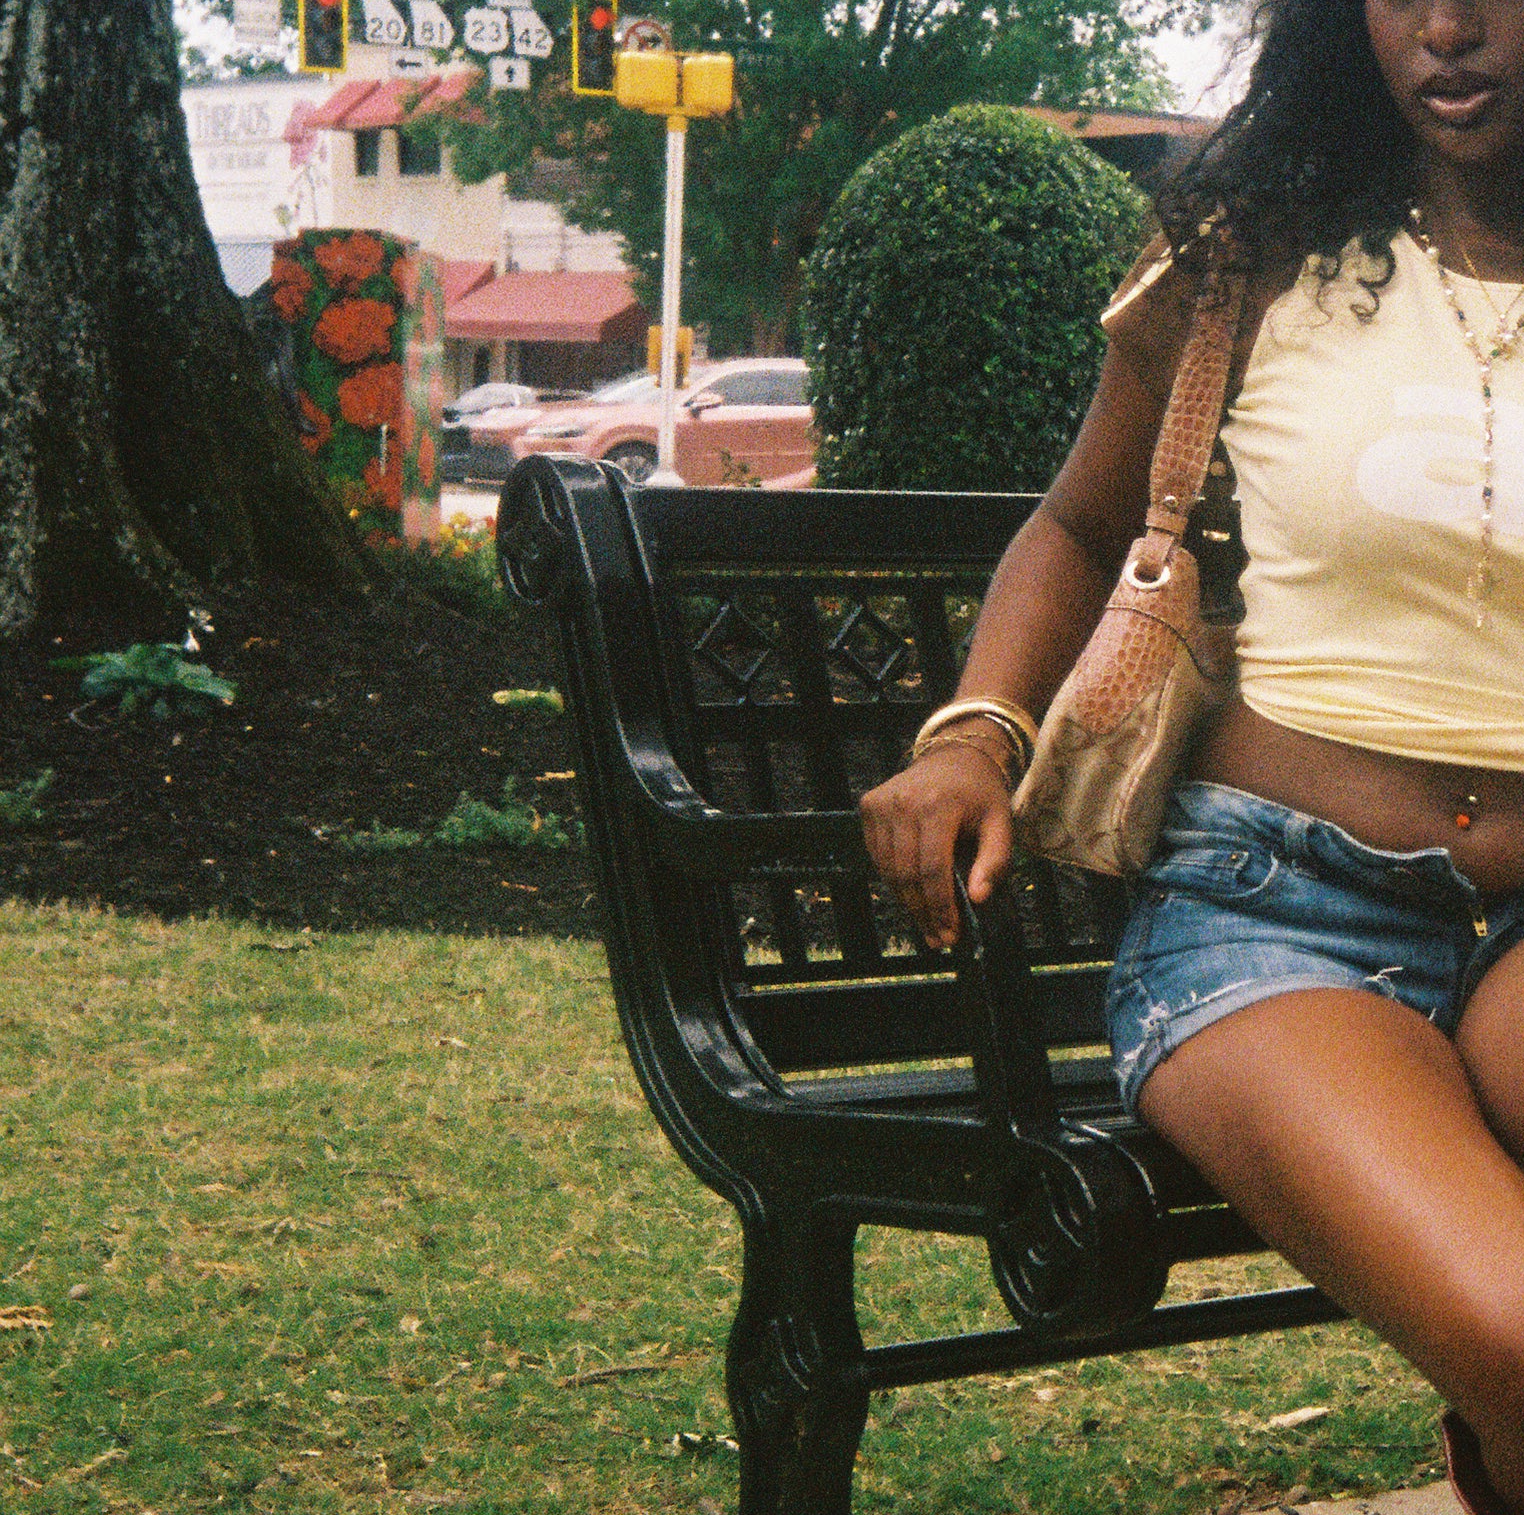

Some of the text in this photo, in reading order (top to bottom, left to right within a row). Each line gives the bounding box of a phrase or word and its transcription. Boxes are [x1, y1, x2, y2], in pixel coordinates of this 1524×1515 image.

[369, 17, 402, 41] 20
[421, 20, 445, 44] 81
[471, 20, 502, 43] 23
[517, 28, 548, 51] 42
